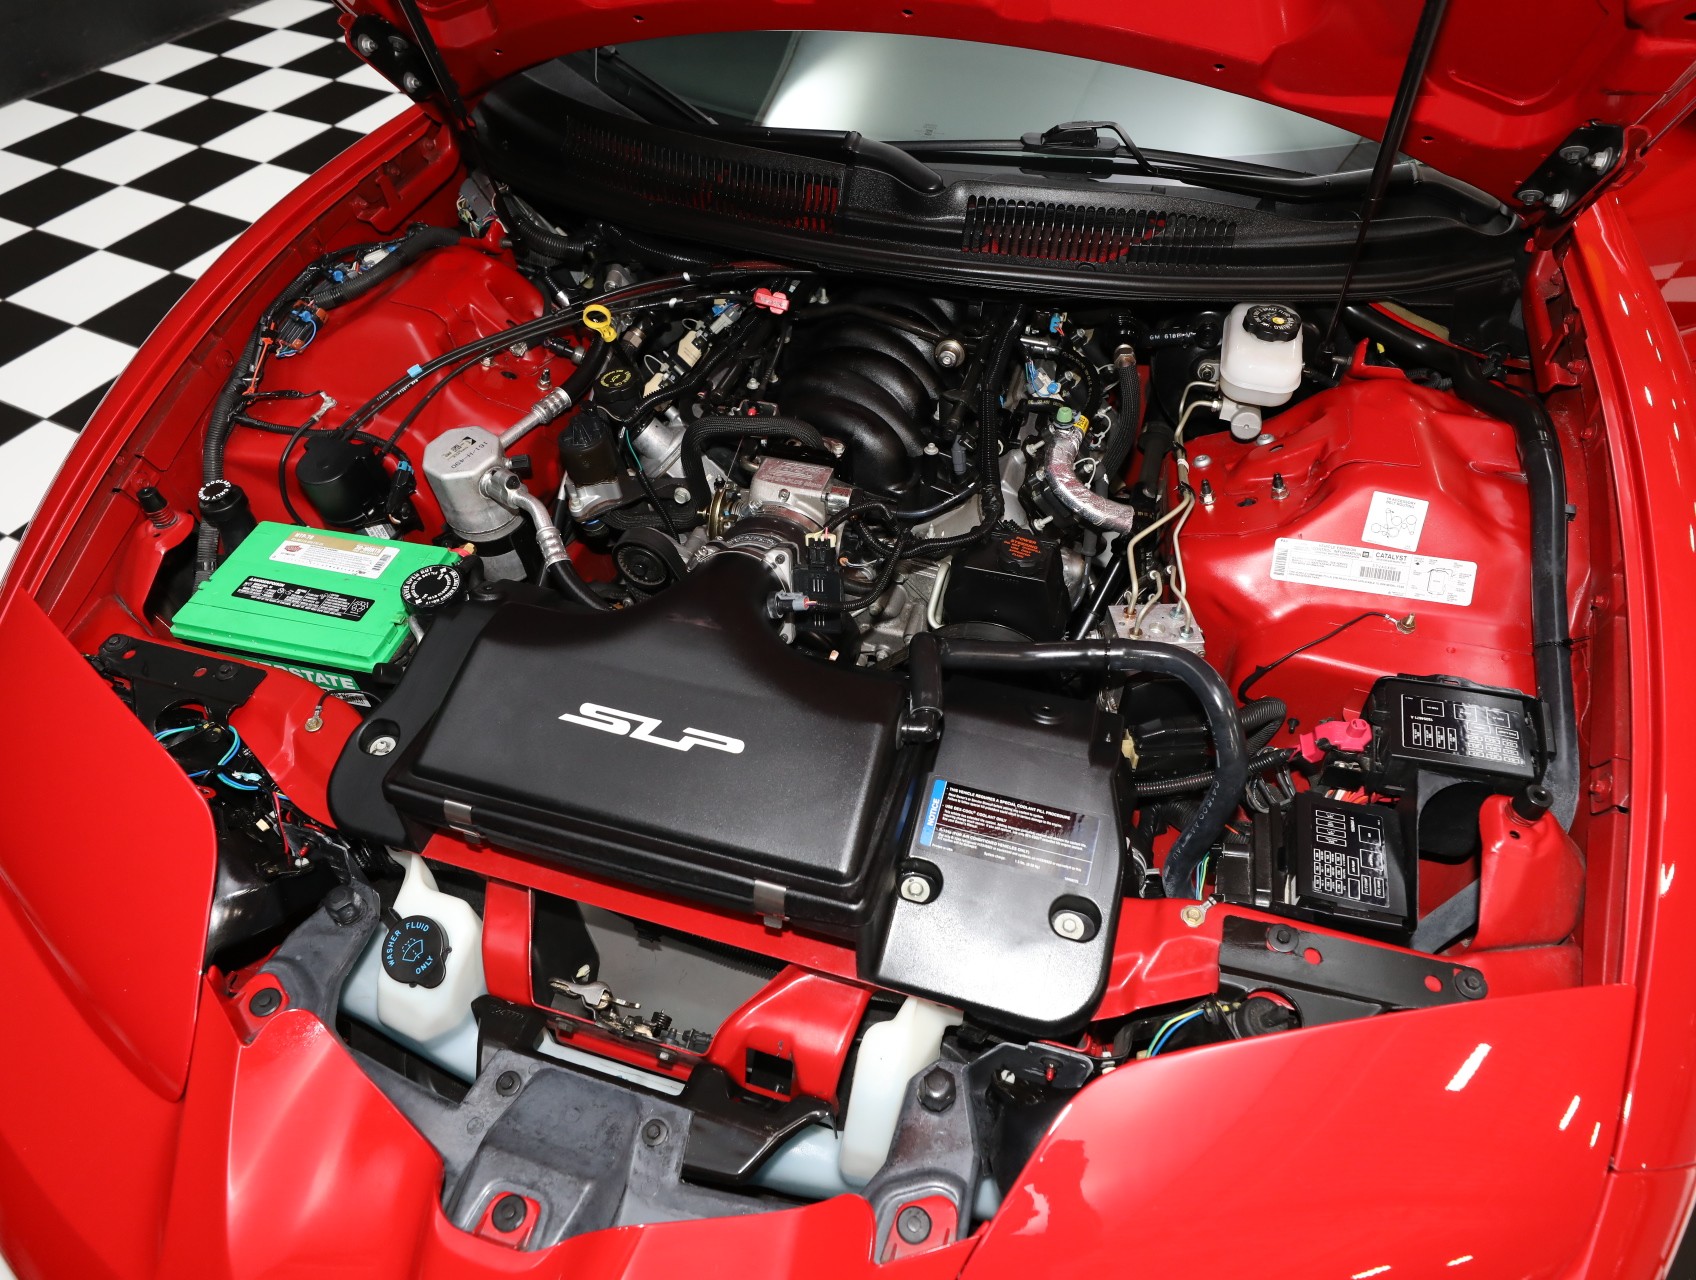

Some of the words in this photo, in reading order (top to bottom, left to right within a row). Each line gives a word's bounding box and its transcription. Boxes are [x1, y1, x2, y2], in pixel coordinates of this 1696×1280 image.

[1016, 536, 1037, 544] POWER
[1375, 552, 1408, 561] CATALYST
[558, 702, 745, 754] SLP
[927, 798, 940, 827] NOTICE
[958, 789, 975, 797] VEHICLE
[975, 793, 996, 802] REQUIRES
[1017, 804, 1036, 812] COOLANT
[1046, 811, 1071, 820] PROCEDURE
[976, 811, 996, 820] COOLANT
[970, 835, 997, 846] CONDITIONED
[998, 842, 1017, 851] VEHICLES
[387, 930, 402, 967] WASHER
[406, 922, 430, 932] FLUID
[415, 955, 433, 975] ONLY
